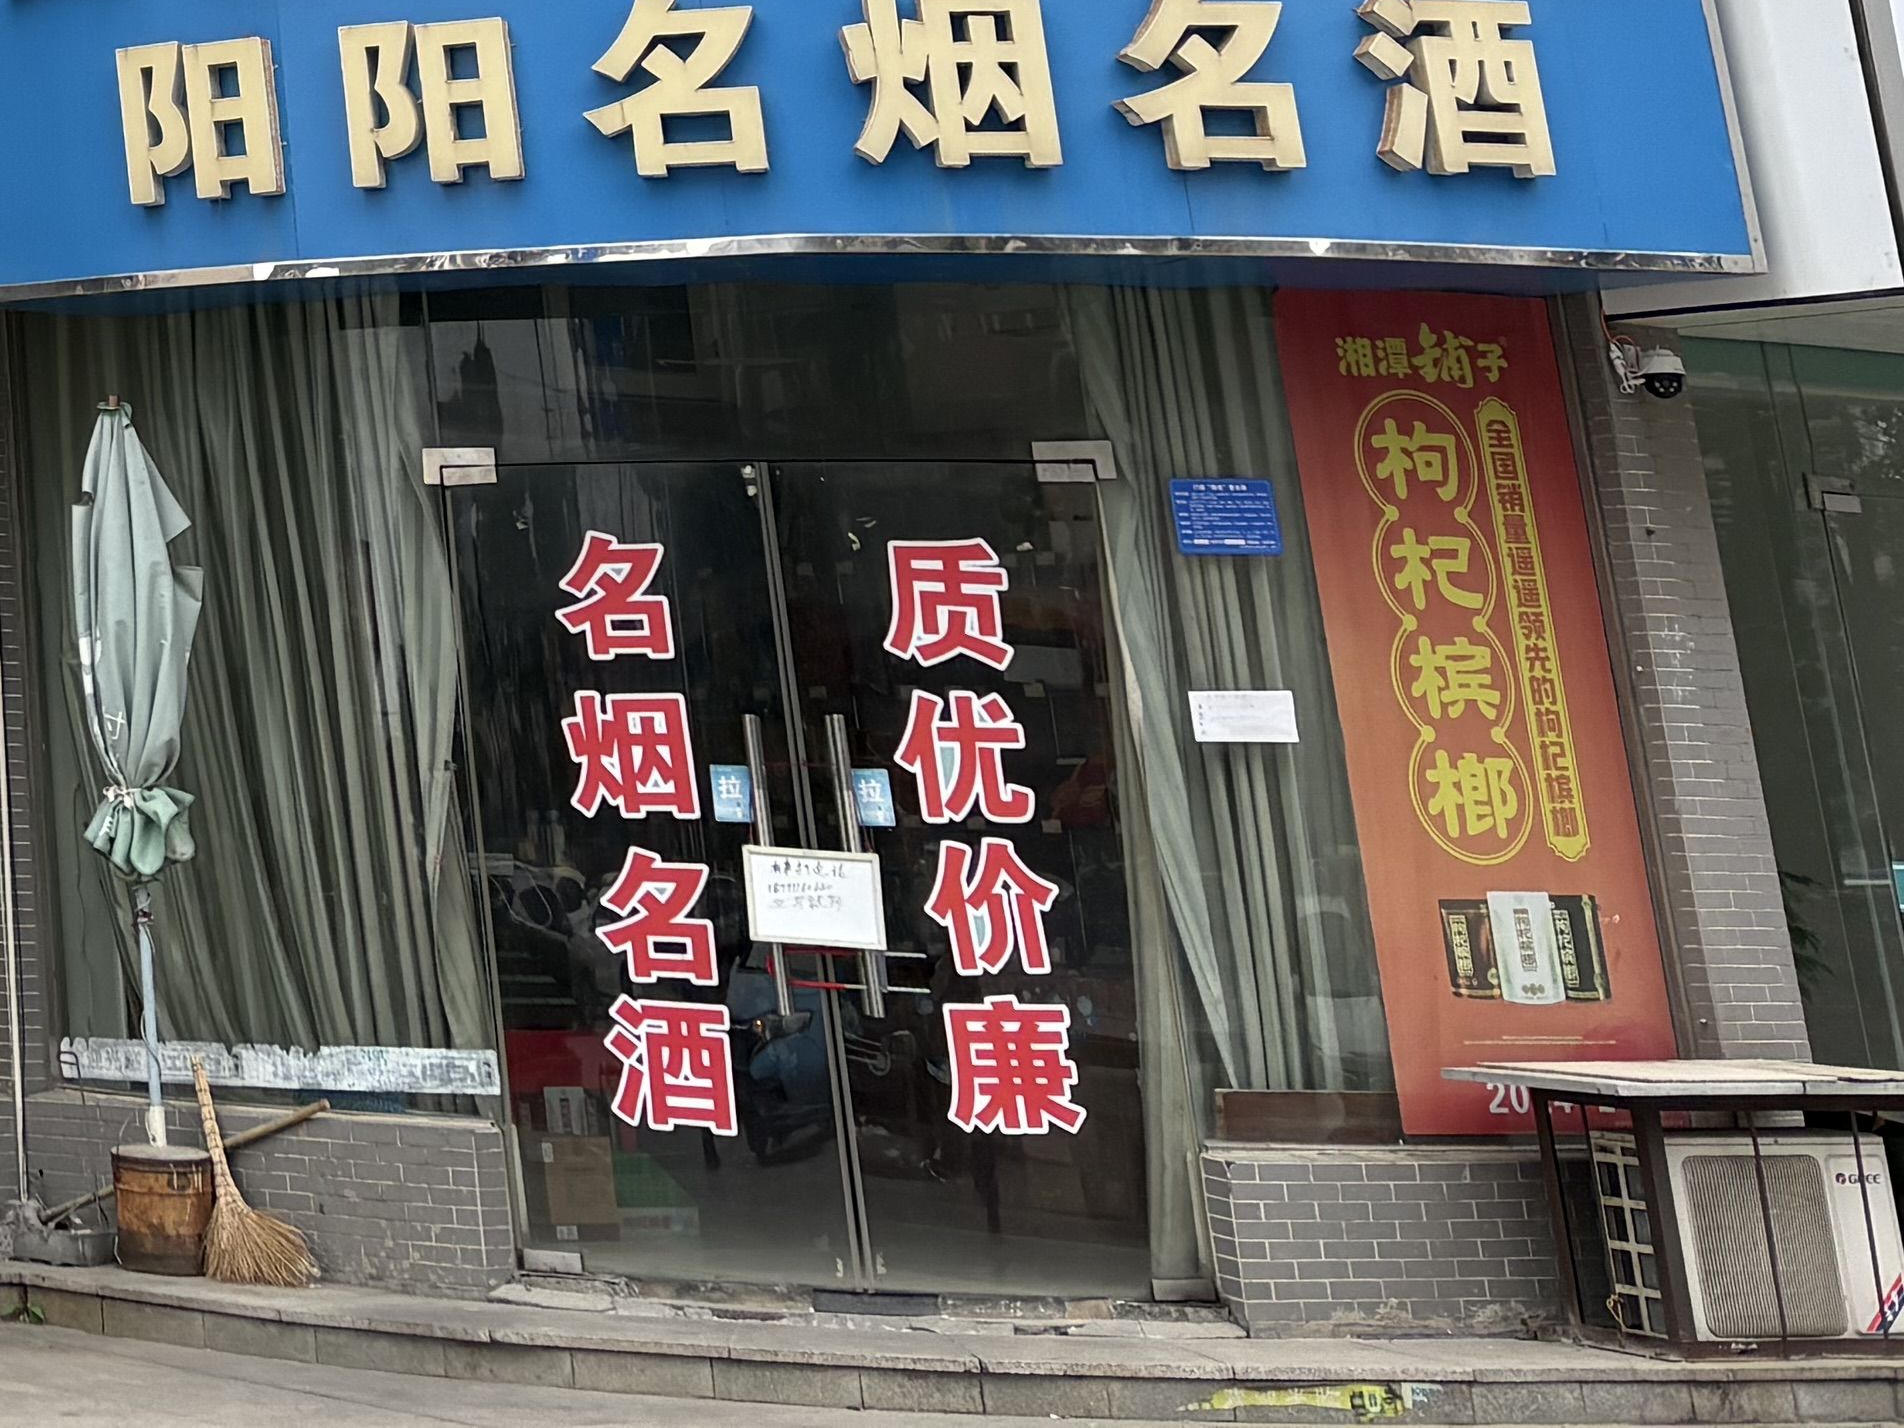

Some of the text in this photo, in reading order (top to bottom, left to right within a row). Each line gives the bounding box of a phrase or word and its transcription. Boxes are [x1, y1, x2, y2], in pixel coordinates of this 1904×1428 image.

[1335, 322, 1508, 388] 湘潭铺子
[1372, 417, 1519, 843] 枸杞槟榔
[555, 530, 740, 1138] 名烟名酒
[718, 776, 743, 800] 拉
[858, 779, 885, 803] 拉
[883, 537, 1087, 1137] 质优价廉
